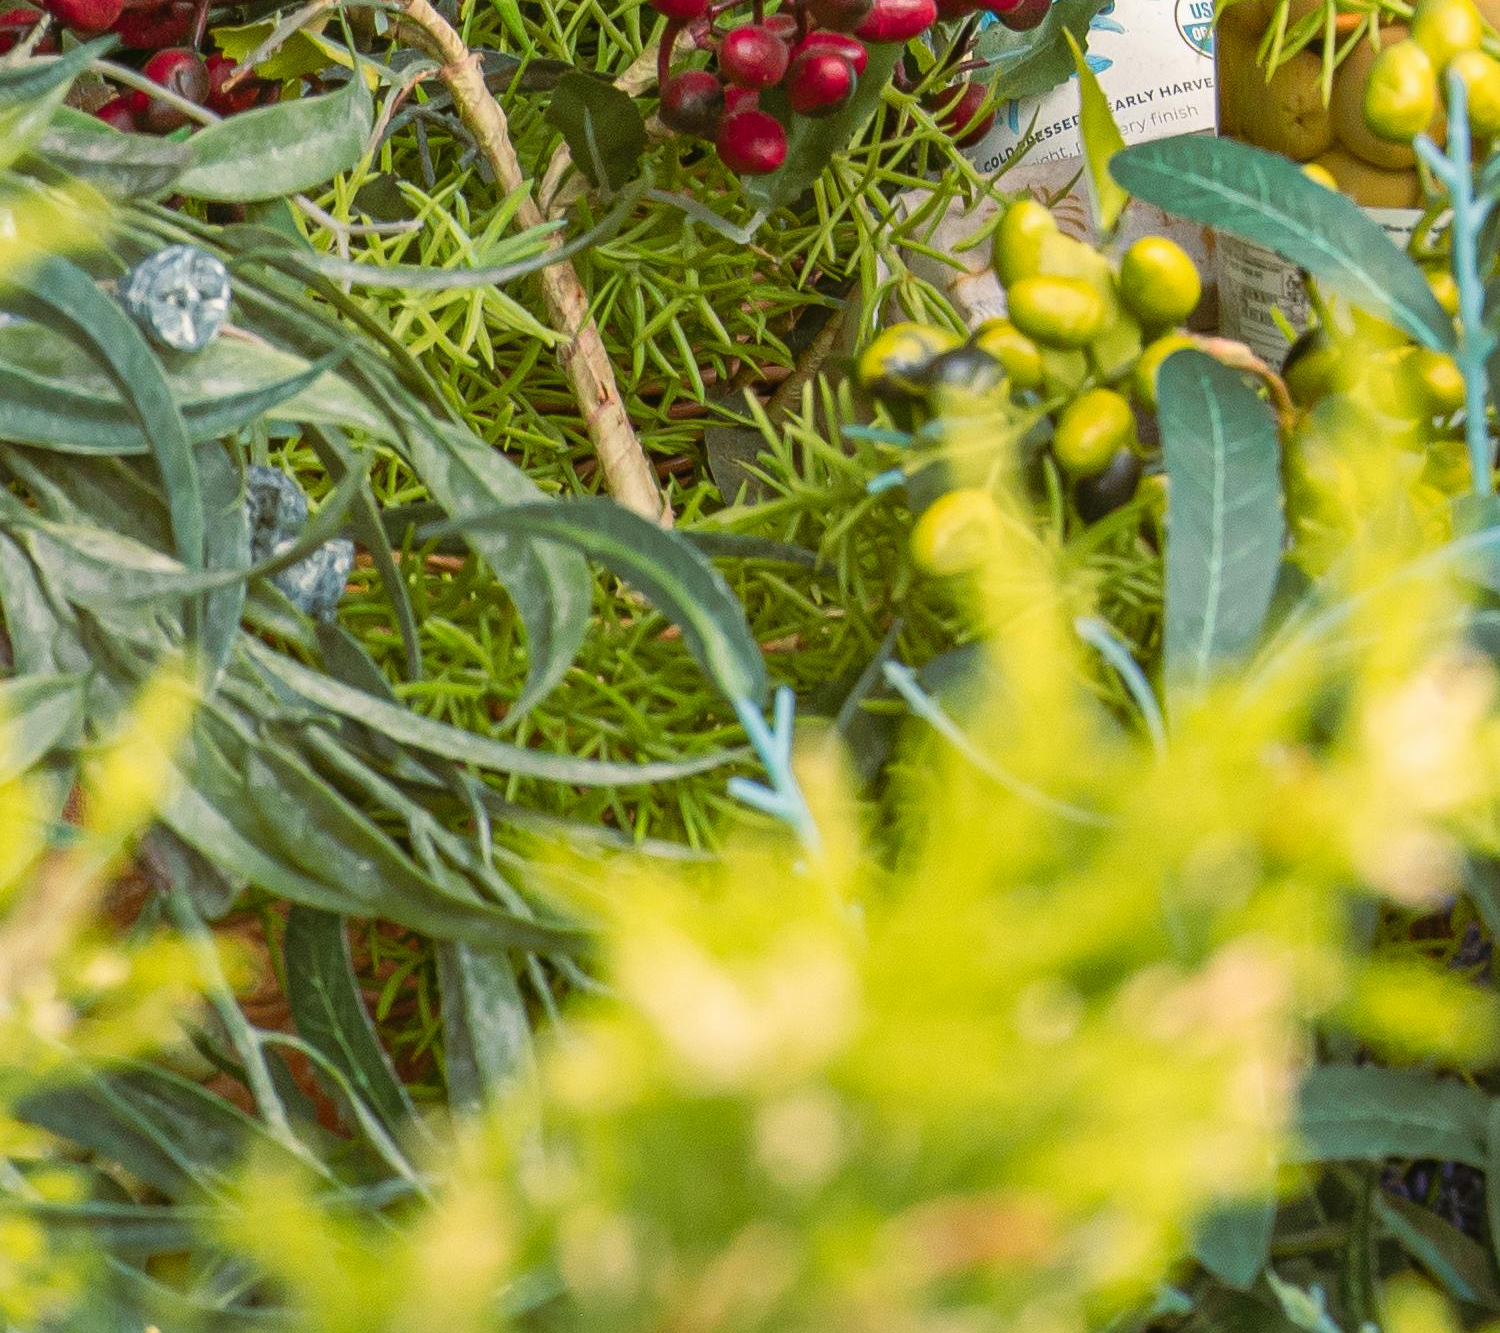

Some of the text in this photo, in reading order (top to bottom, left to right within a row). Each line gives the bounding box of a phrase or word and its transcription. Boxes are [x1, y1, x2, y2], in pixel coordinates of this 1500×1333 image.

[984, 148, 1015, 174] COLD
[1160, 77, 1214, 100] HARVE
[1149, 103, 1199, 127] finish
